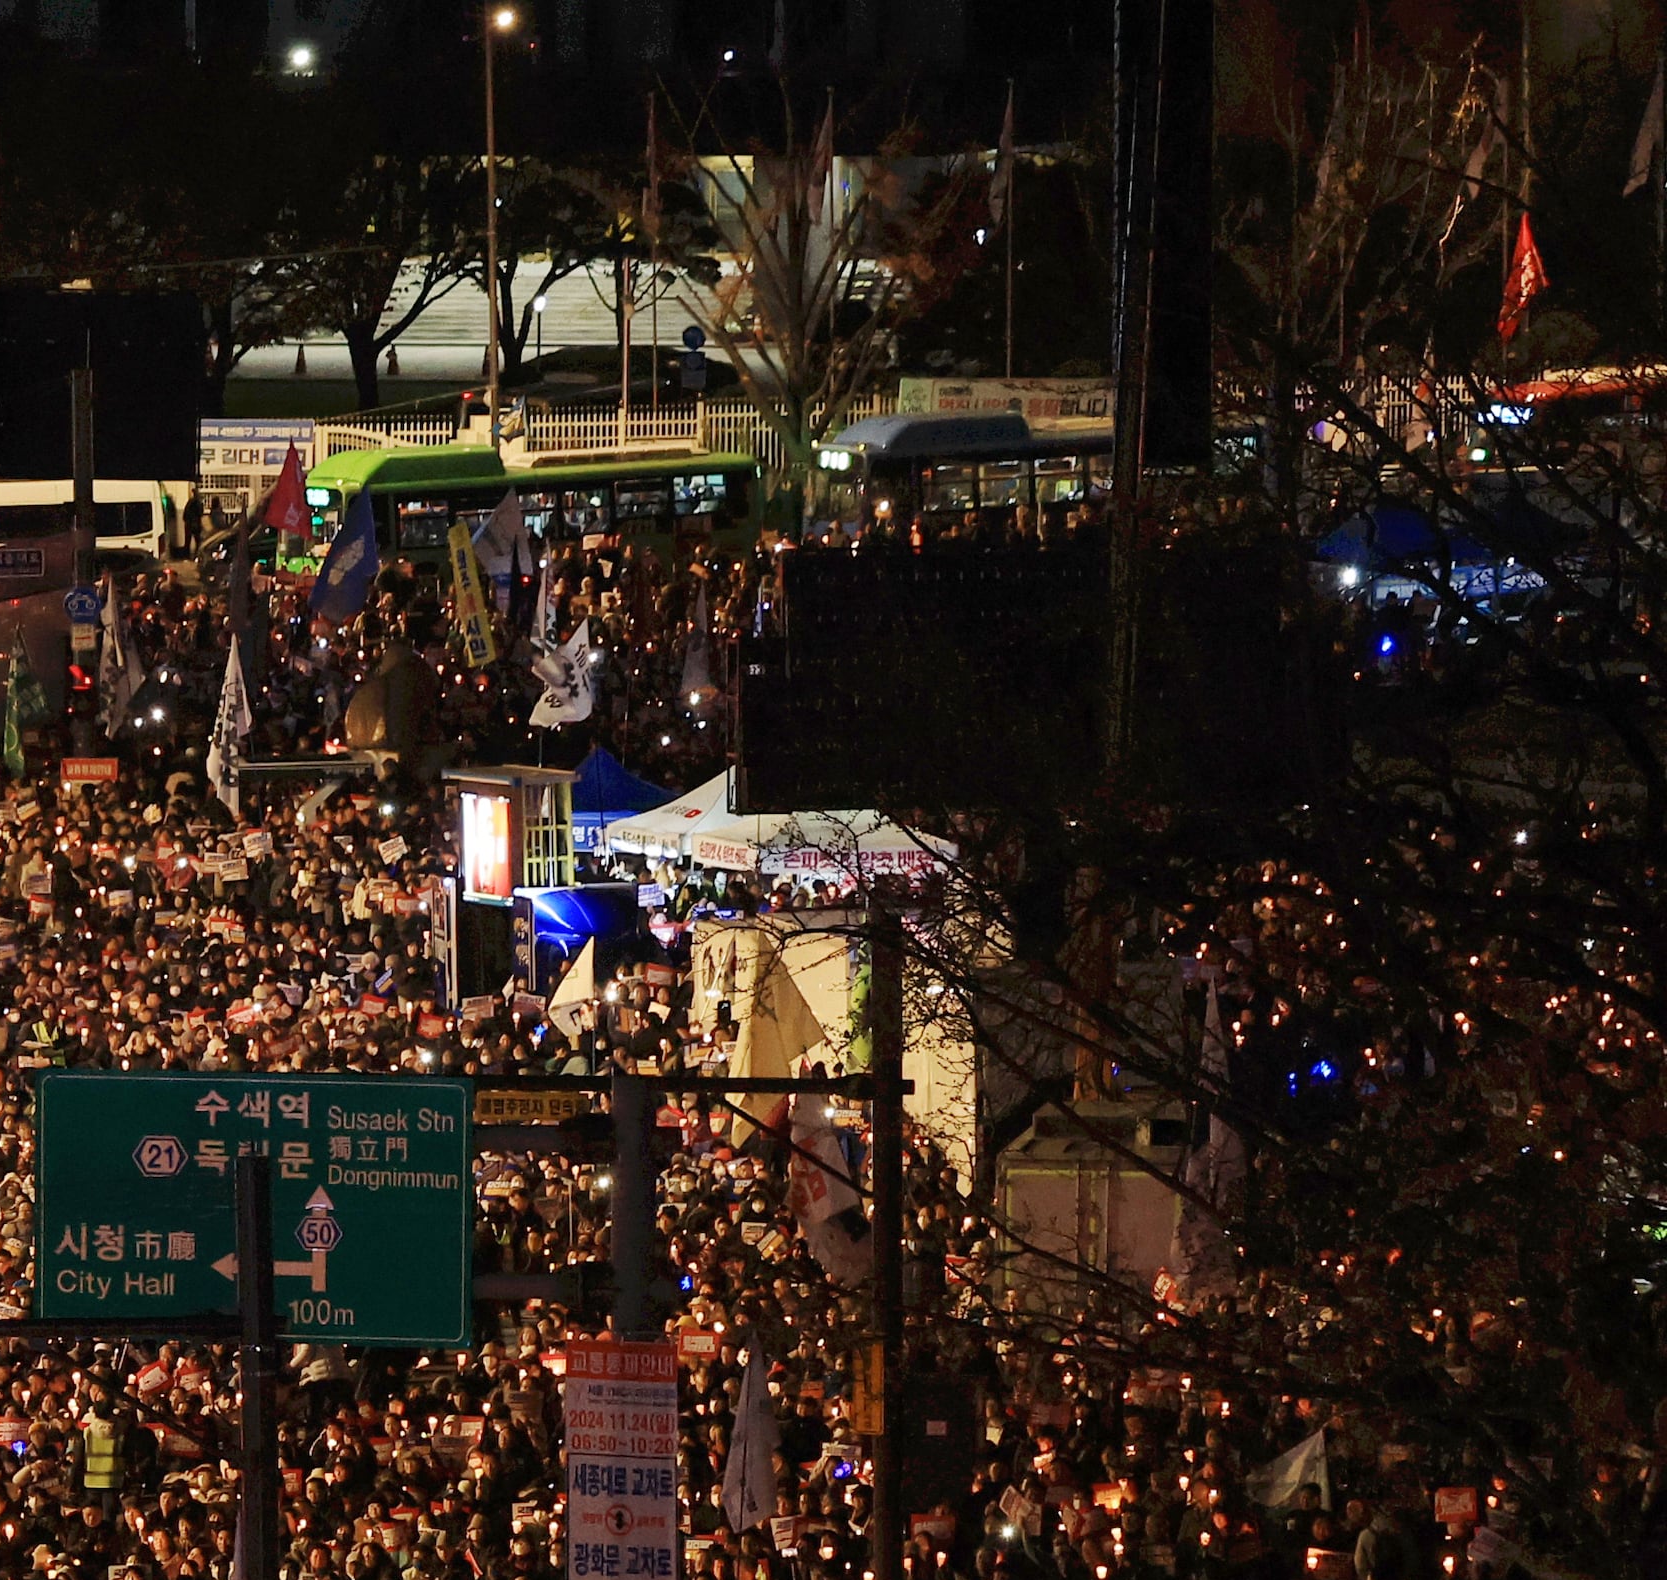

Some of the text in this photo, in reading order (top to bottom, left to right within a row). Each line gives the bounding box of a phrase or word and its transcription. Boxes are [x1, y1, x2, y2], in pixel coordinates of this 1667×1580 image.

[194, 1091, 311, 1129] 수색역
[328, 1106, 455, 1133] Susaek Stn
[147, 1145, 174, 1169] 21
[328, 1136, 409, 1162] 獨立門
[328, 1164, 458, 1191] Dongnimmun
[55, 1223, 196, 1262] 시청 市廳
[305, 1223, 332, 1244] 50
[56, 1270, 175, 1299] City Hall
[289, 1300, 355, 1326] 100m
[572, 1434, 674, 1454] 06:50~10:20
[573, 1464, 674, 1498] 세종대로 교차로
[574, 1543, 672, 1578] 광화문 교차로
